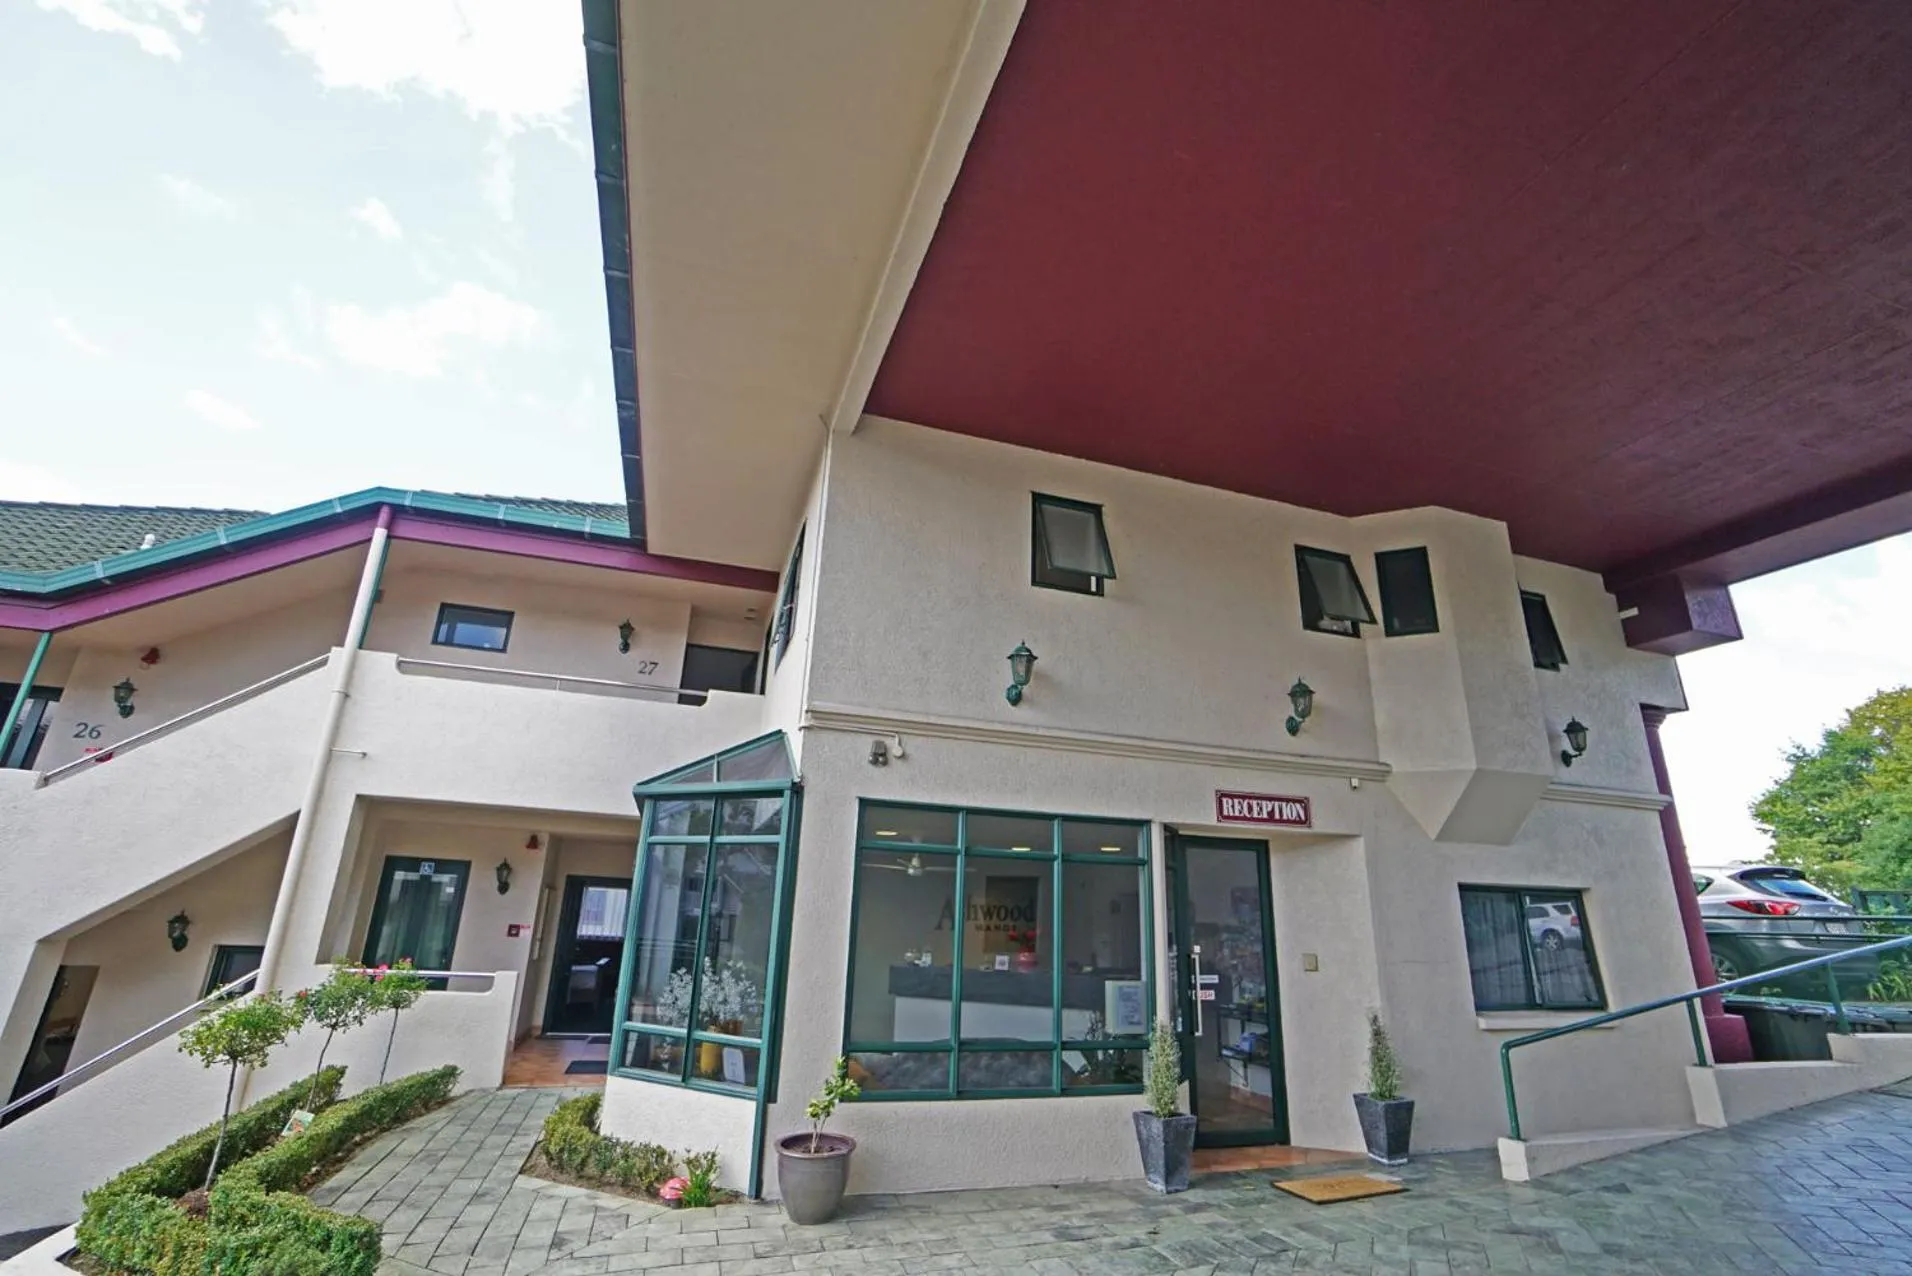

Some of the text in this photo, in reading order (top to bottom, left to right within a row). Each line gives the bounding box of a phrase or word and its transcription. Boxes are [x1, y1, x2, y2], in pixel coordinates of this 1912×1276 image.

[638, 660, 659, 676] 27
[72, 722, 106, 740] 26
[1221, 797, 1306, 821] RECEPTION
[934, 894, 1037, 931] Ahwood
